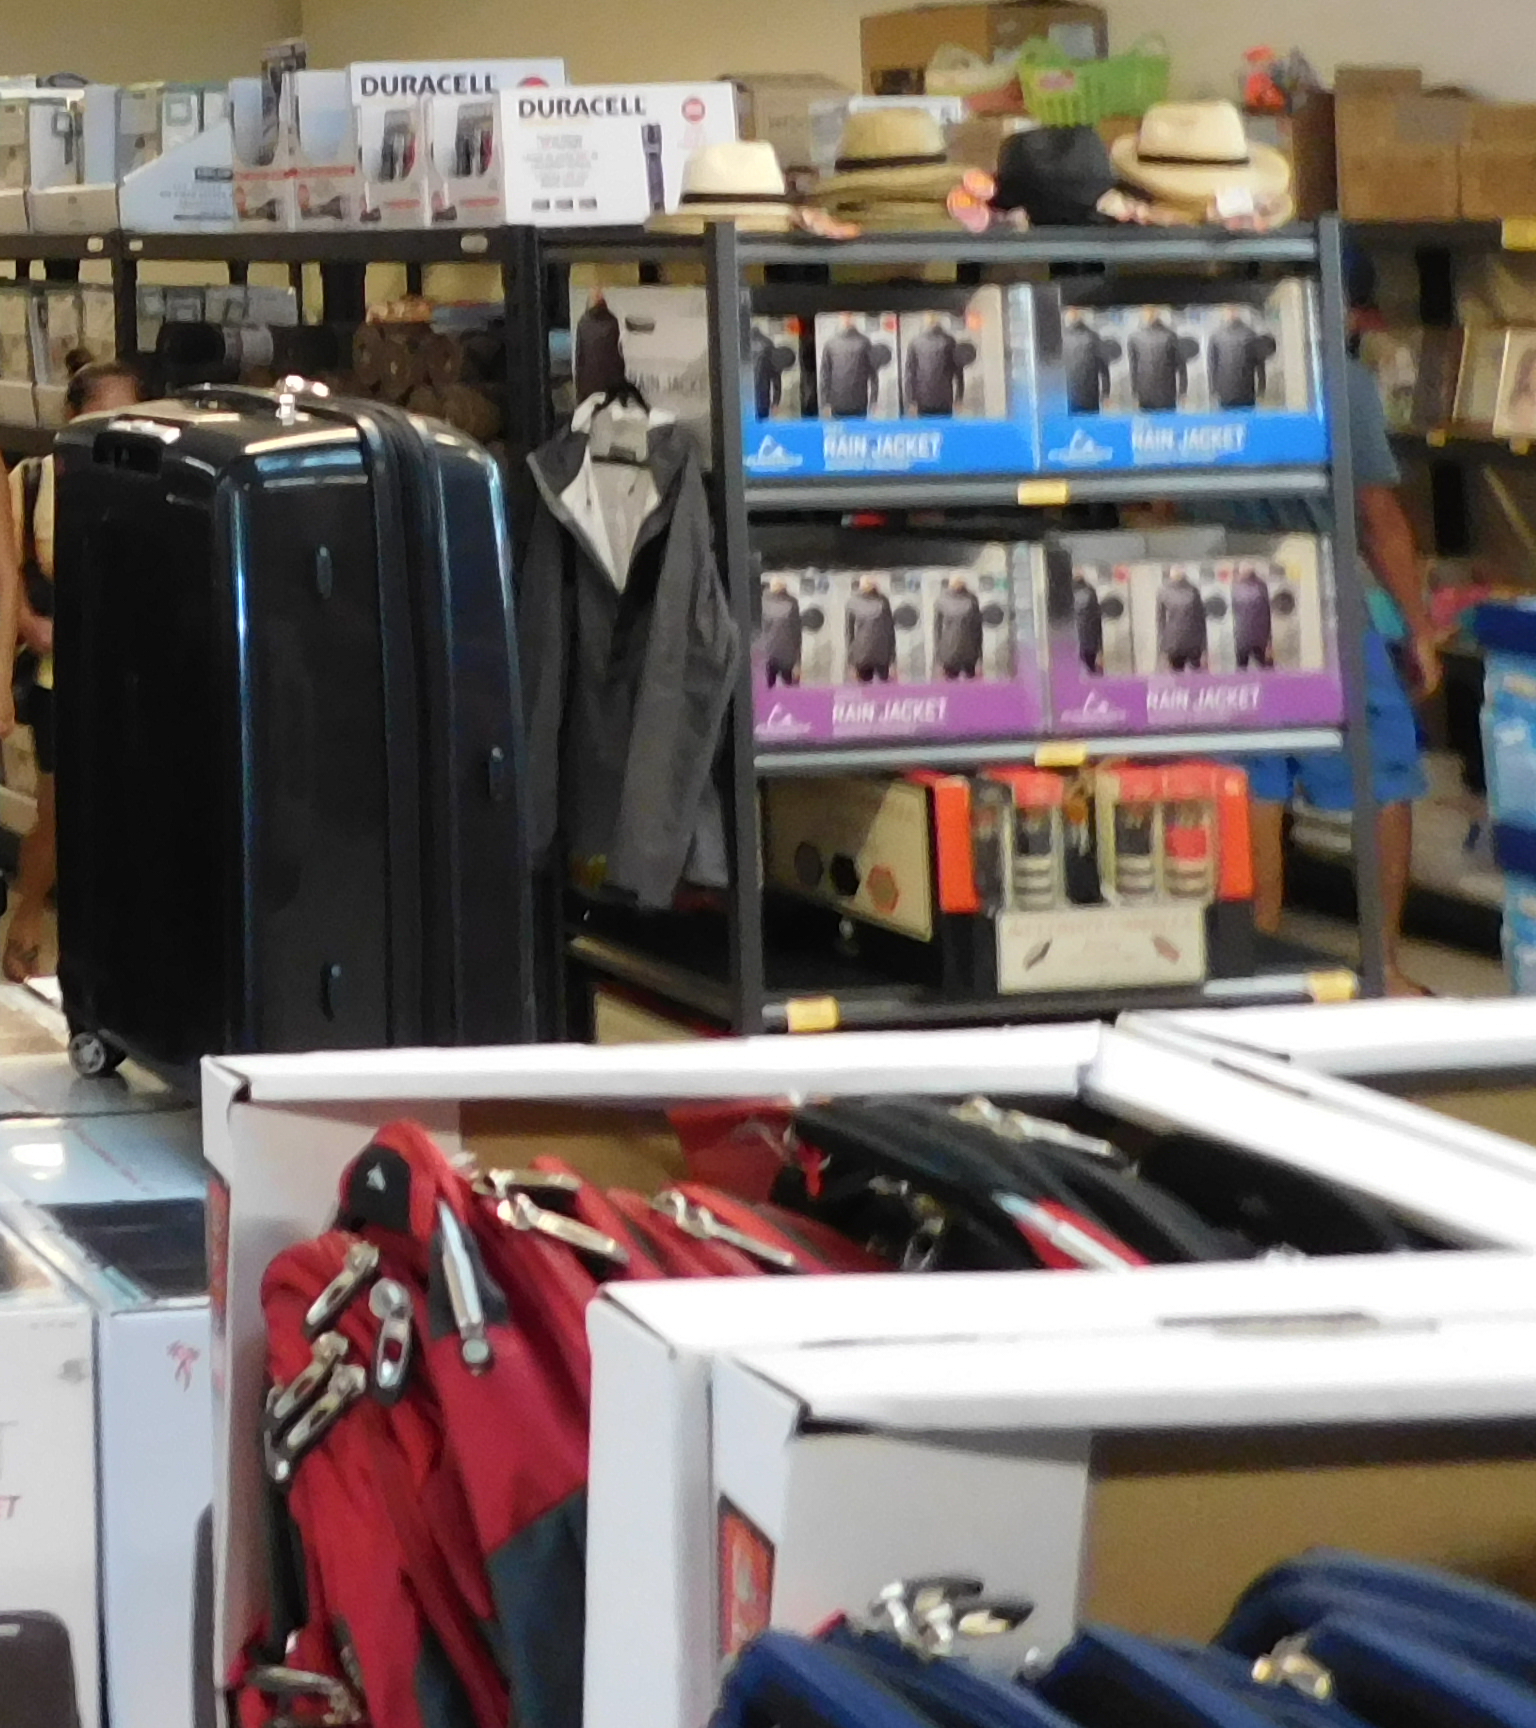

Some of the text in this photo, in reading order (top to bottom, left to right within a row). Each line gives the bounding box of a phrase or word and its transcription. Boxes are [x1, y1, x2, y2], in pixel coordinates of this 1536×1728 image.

[360, 74, 499, 96] DURACELL
[517, 96, 647, 119] DURACELL
[877, 696, 948, 722] JACKET
